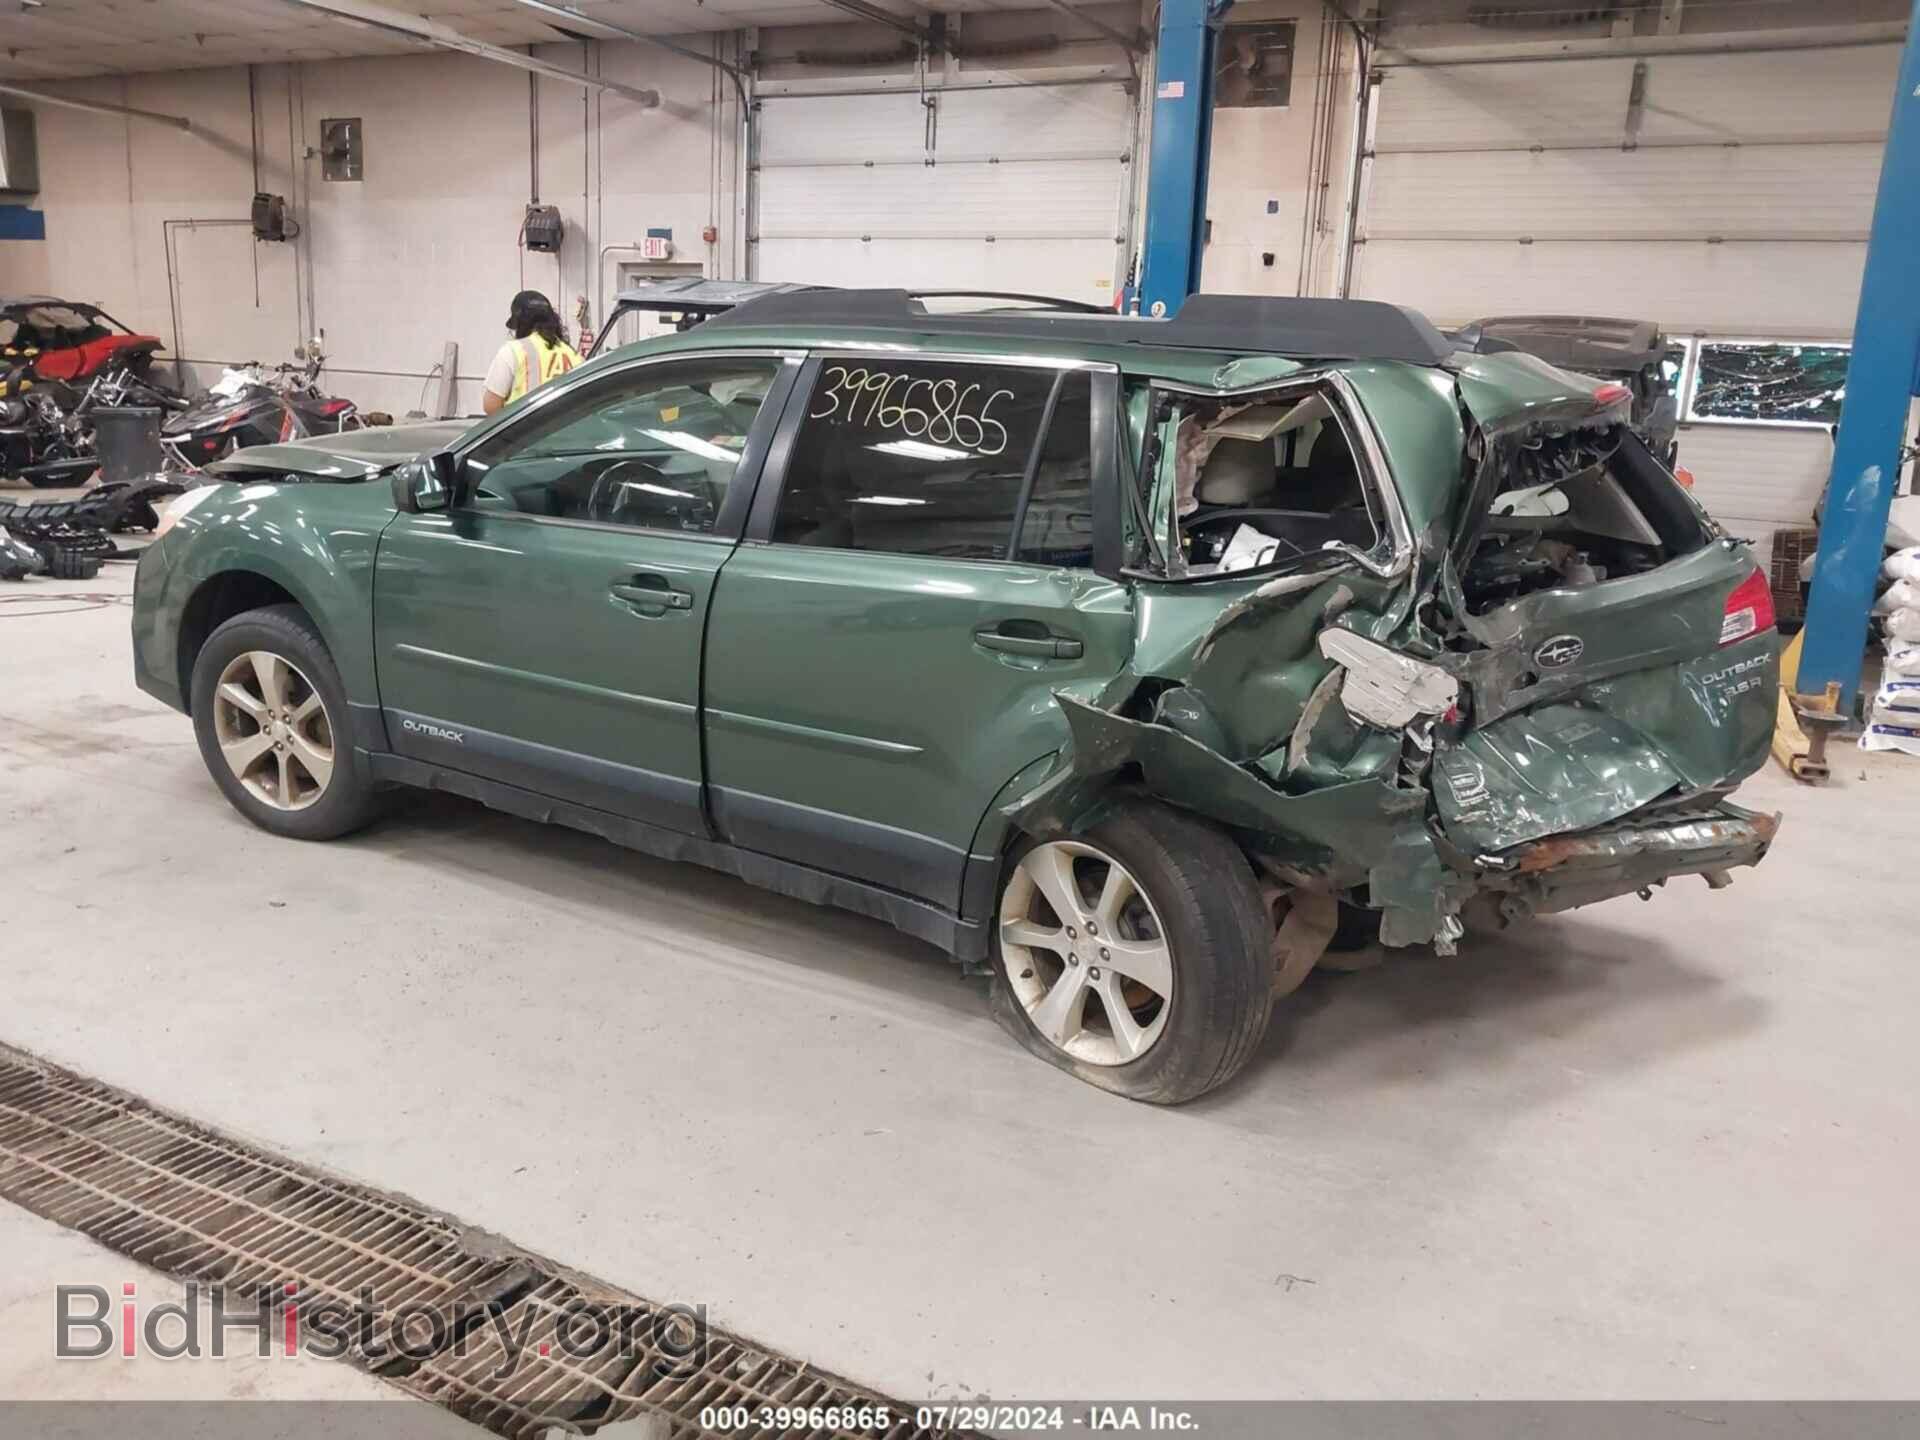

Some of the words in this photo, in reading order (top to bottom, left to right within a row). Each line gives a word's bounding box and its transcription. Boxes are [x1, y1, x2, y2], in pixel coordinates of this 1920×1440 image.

[645, 239, 662, 257] EXIT
[811, 366, 1015, 455] 39966865
[1701, 652, 1771, 685] OUTBACK
[403, 719, 463, 742] OUTBACK
